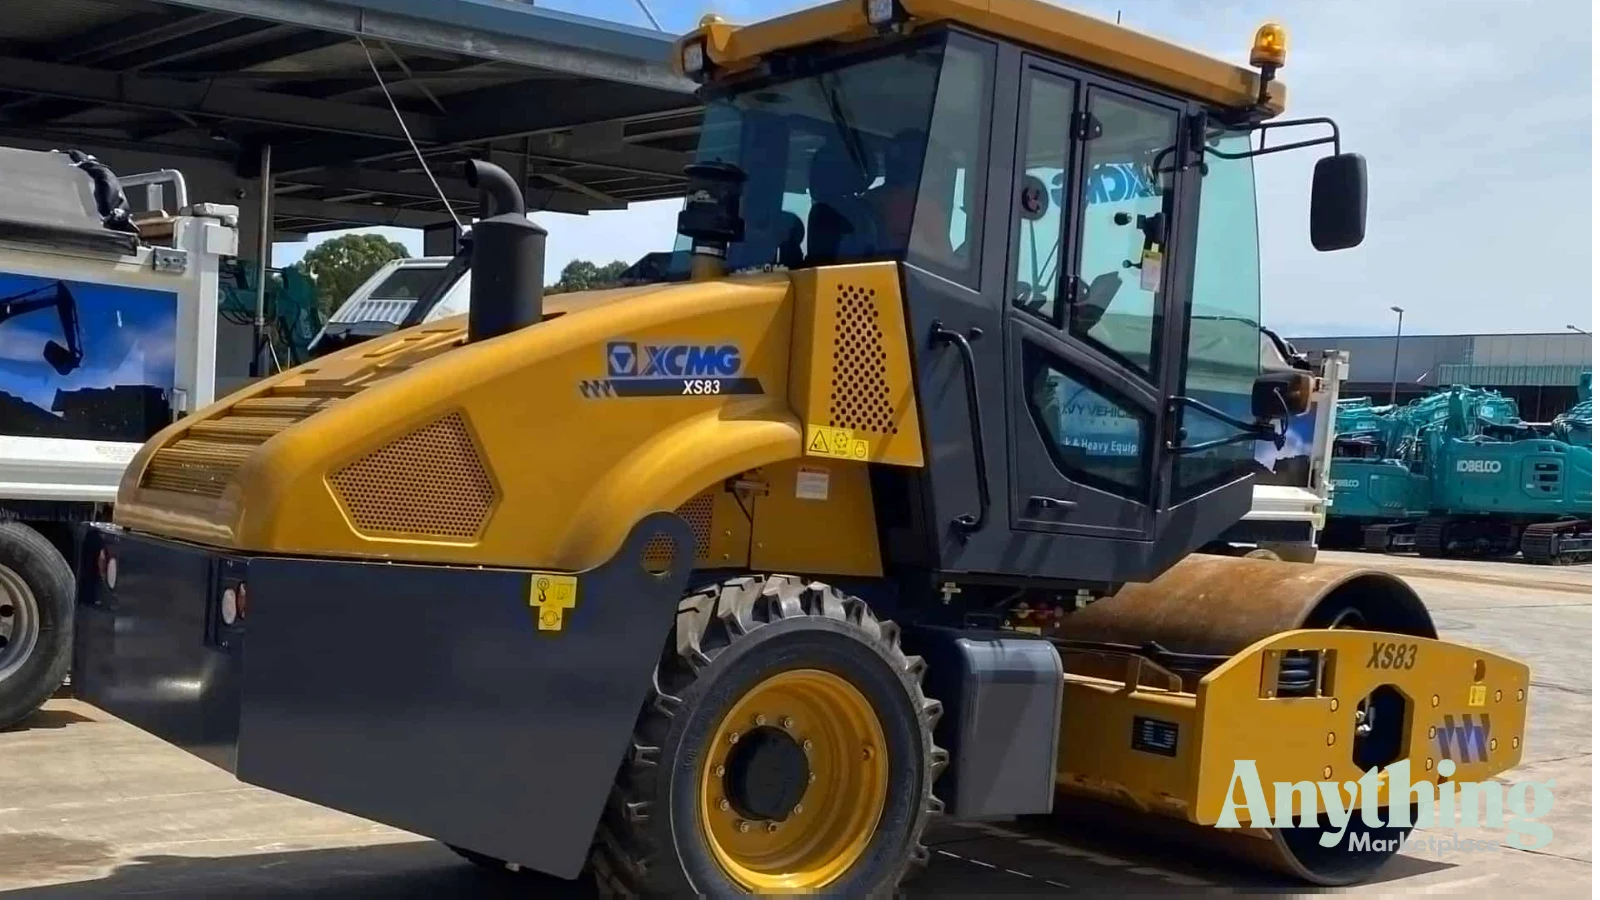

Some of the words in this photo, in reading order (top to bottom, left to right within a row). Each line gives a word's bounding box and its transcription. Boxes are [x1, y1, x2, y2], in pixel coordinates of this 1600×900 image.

[639, 345, 741, 376] XCMG
[682, 380, 720, 395] XS83
[1081, 439, 1109, 454] Heavy
[1456, 460, 1502, 473] KOBELCO
[1366, 642, 1418, 670] XS83
